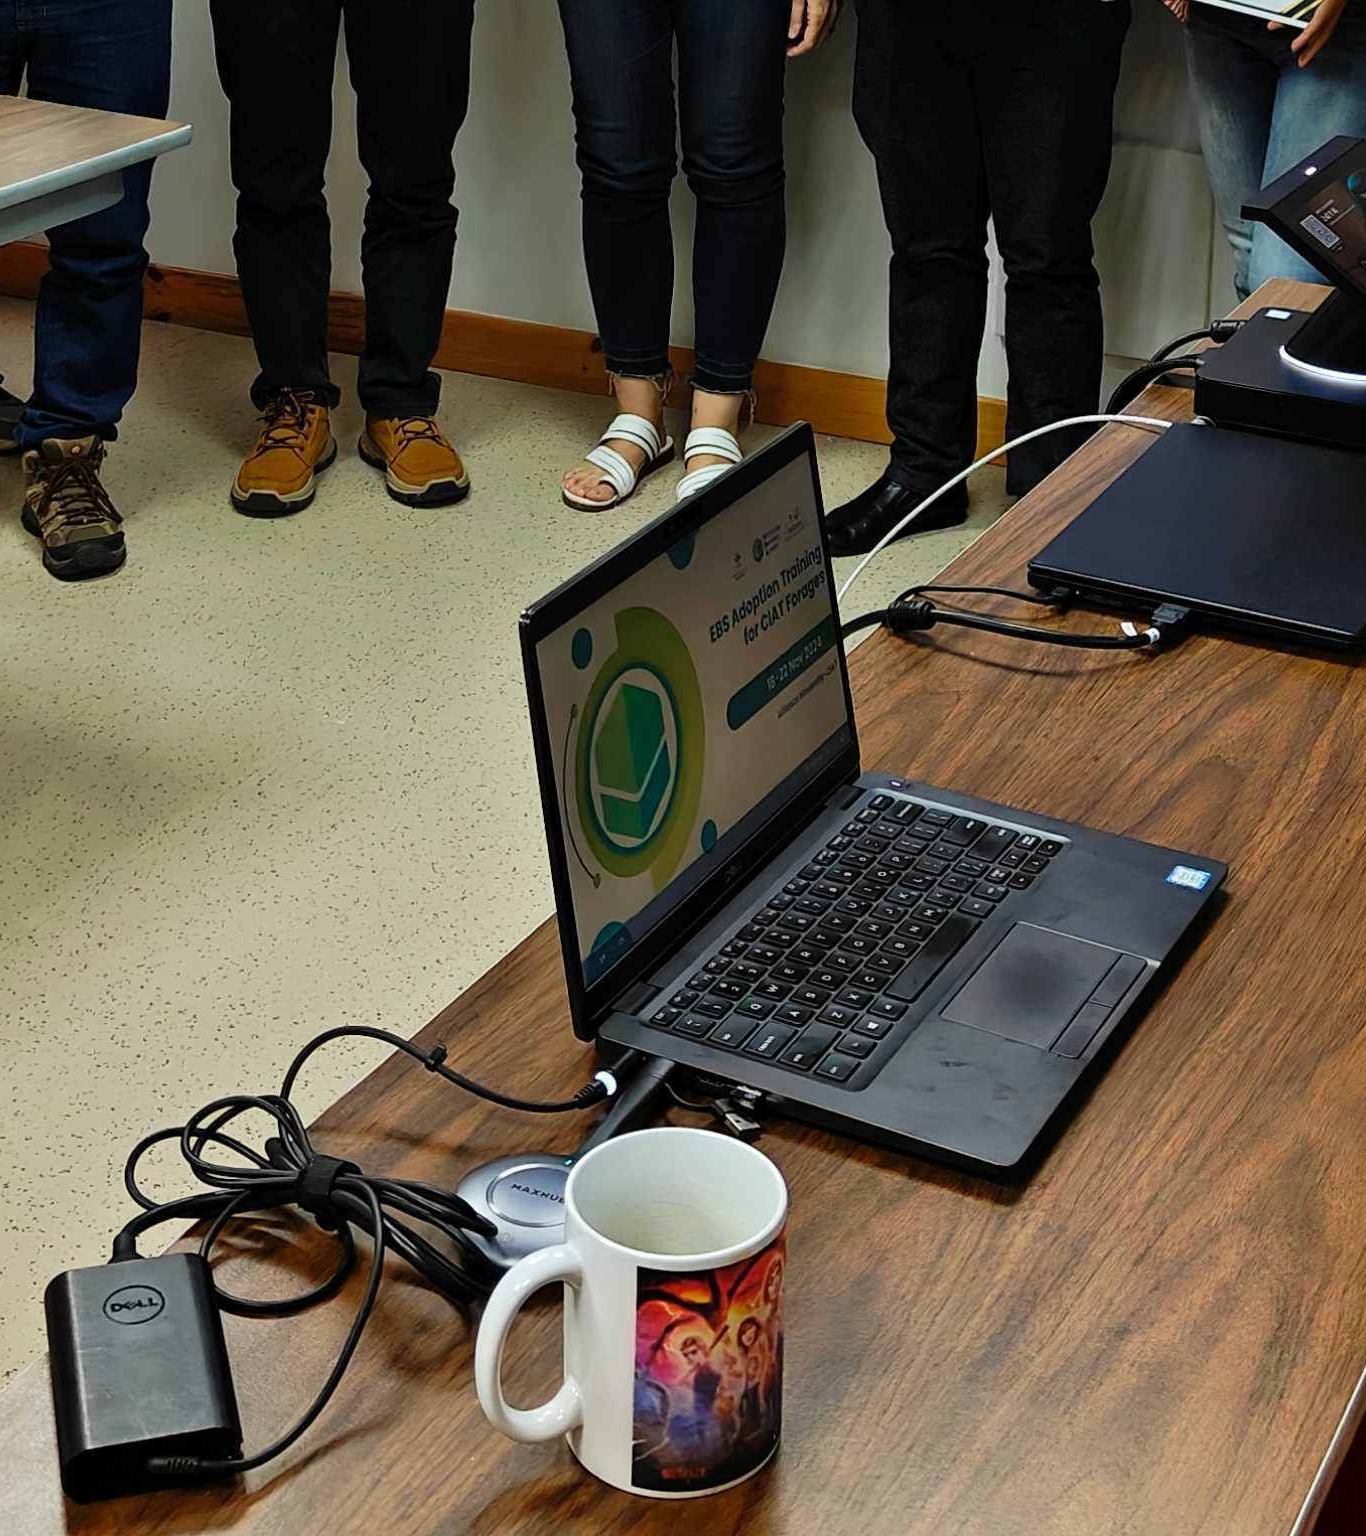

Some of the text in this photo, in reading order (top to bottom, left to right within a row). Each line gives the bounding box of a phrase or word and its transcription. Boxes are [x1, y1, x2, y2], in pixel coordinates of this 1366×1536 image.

[709, 545, 823, 643] EBS Adoption Training
[743, 570, 826, 645] for CIAT Forages
[110, 1296, 160, 1313] DELL
